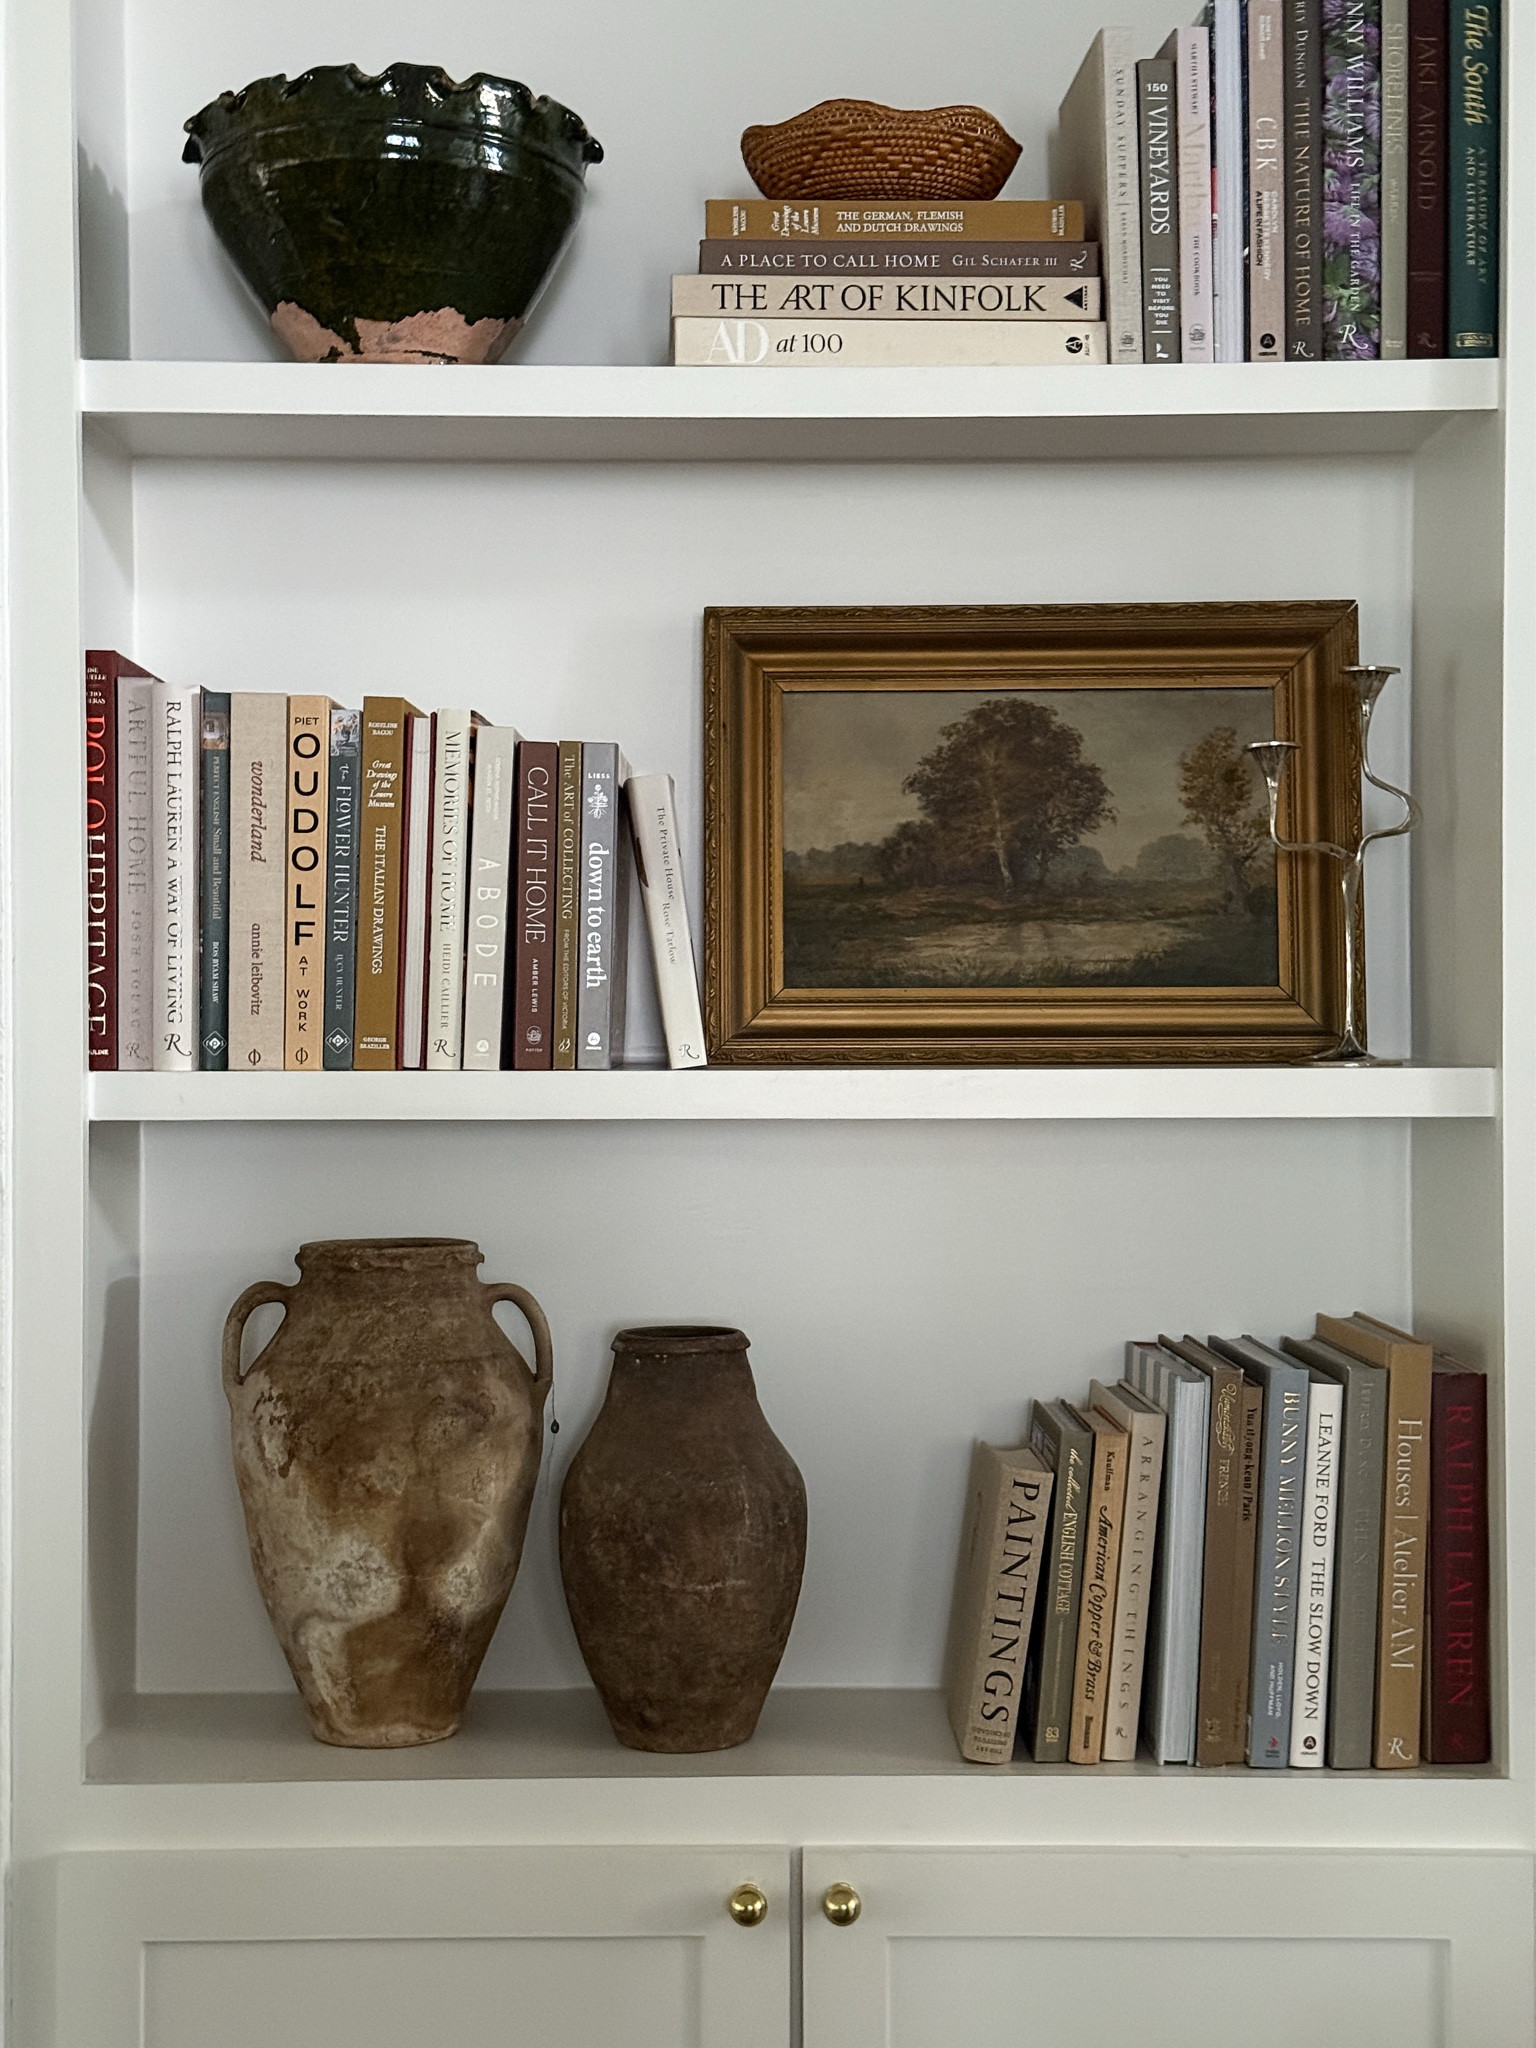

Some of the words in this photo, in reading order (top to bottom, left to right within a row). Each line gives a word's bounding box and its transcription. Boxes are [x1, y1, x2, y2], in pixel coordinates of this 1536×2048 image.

[1463, 5, 1489, 50] The
[1295, 30, 1309, 88] DUNGAN
[1115, 69, 1126, 126] SUNDAY
[1147, 83, 1168, 92] 150
[1346, 54, 1364, 168] WILLIAMS
[1462, 55, 1490, 127] South
[1294, 98, 1310, 140] THE
[1117, 136, 1127, 198] SUPPERS
[1148, 105, 1170, 235] VINEYARDS
[1418, 105, 1438, 211] ARNOLD
[1466, 146, 1475, 177] AND
[1294, 146, 1311, 229] NATURE
[1351, 183, 1360, 208] LIFE
[837, 211, 860, 221] THE
[917, 211, 964, 221] FLEMISH
[837, 223, 861, 232] AND
[863, 223, 901, 232] DUTCH
[905, 223, 964, 232] DRAWINGS
[1256, 219, 1262, 227] IN
[1351, 214, 1360, 228] IN
[1466, 183, 1475, 266] LITERATURE
[721, 255, 733, 267] A
[739, 255, 796, 267] PLACE
[801, 255, 827, 267] TO
[832, 254, 880, 268] CALL
[886, 254, 940, 267] HOME
[1295, 234, 1311, 260] OF
[1351, 233, 1360, 255] THE
[712, 284, 767, 311] THE
[777, 284, 834, 311] ART
[840, 284, 883, 311] OF
[896, 285, 1047, 312] KINFOLK
[1295, 266, 1310, 326] HOME
[1350, 260, 1360, 311] GARDEN
[705, 322, 771, 364] AD
[776, 334, 796, 354] at
[802, 333, 843, 354] 100
[166, 700, 183, 765] RALPH
[294, 716, 319, 726] PIET
[128, 700, 147, 810] ARTFUL
[564, 755, 576, 779] The
[442, 730, 462, 835] MEMORIES
[527, 767, 549, 831] CALL
[563, 782, 575, 809] ART
[166, 772, 183, 853] LAUREN
[251, 760, 266, 863] wonderland
[333, 785, 352, 857] FLOWER
[563, 812, 576, 825] of
[656, 806, 666, 826] The
[128, 817, 147, 895] HOME
[167, 857, 182, 870] A
[213, 827, 222, 854] Small
[291, 733, 320, 946] OUDOLF
[375, 825, 387, 851] THE
[441, 839, 457, 866] OF
[526, 838, 549, 859] IT
[659, 829, 671, 865] Private
[213, 856, 222, 874] and
[374, 854, 386, 906] ITALIAN
[561, 828, 575, 919] COLLECTING
[587, 842, 610, 902] down
[665, 868, 676, 899] House
[166, 876, 183, 917] WAY
[213, 876, 222, 920] Beautiful
[333, 864, 351, 942] HUNTER
[439, 872, 456, 932] HOME
[525, 867, 547, 944] HOME
[587, 908, 607, 928] to
[662, 902, 672, 927] Rose
[166, 922, 183, 949] OF
[251, 923, 263, 960] annie
[371, 908, 385, 974] DRAWINGS
[442, 943, 452, 974] HEIDI
[586, 931, 608, 989] earth
[666, 931, 676, 965] Tarlow
[166, 955, 183, 1023] LIVING
[212, 981, 220, 1004] SHAW
[250, 963, 265, 1016] leibovitz
[297, 989, 310, 1032] WORK
[335, 976, 343, 1010] HUNTER
[440, 978, 450, 1029] CAILLIER
[563, 991, 568, 1000] OF
[1281, 1391, 1301, 1466] BUNNY
[1316, 1413, 1333, 1488] LEANNE
[1069, 1448, 1083, 1465] the
[1395, 1418, 1423, 1507] Houses
[1445, 1404, 1474, 1532] RALPH
[1066, 1466, 1081, 1512] collected
[1243, 1497, 1254, 1521] Paris
[1059, 1511, 1078, 1561] ENGLISH
[1128, 1436, 1154, 1595] ARRANGING
[1274, 1475, 1297, 1568] MELLON
[1313, 1495, 1330, 1547] FORD
[1093, 1505, 1113, 1580] American
[1055, 1563, 1074, 1615] COTTAGE
[1309, 1558, 1326, 1598] THE
[1391, 1529, 1419, 1615] Atelier
[979, 1478, 1041, 1722] PAINTINGS
[1087, 1583, 1108, 1638] Copper
[1271, 1575, 1293, 1646] STYLE
[1089, 1640, 1104, 1657] &
[1307, 1602, 1324, 1657] SLOW
[1390, 1619, 1416, 1669] AM
[1444, 1551, 1475, 1706] LAUREN
[1084, 1659, 1103, 1702] Brass
[1119, 1611, 1137, 1710] THINGS
[1304, 1661, 1321, 1720] DOWN
